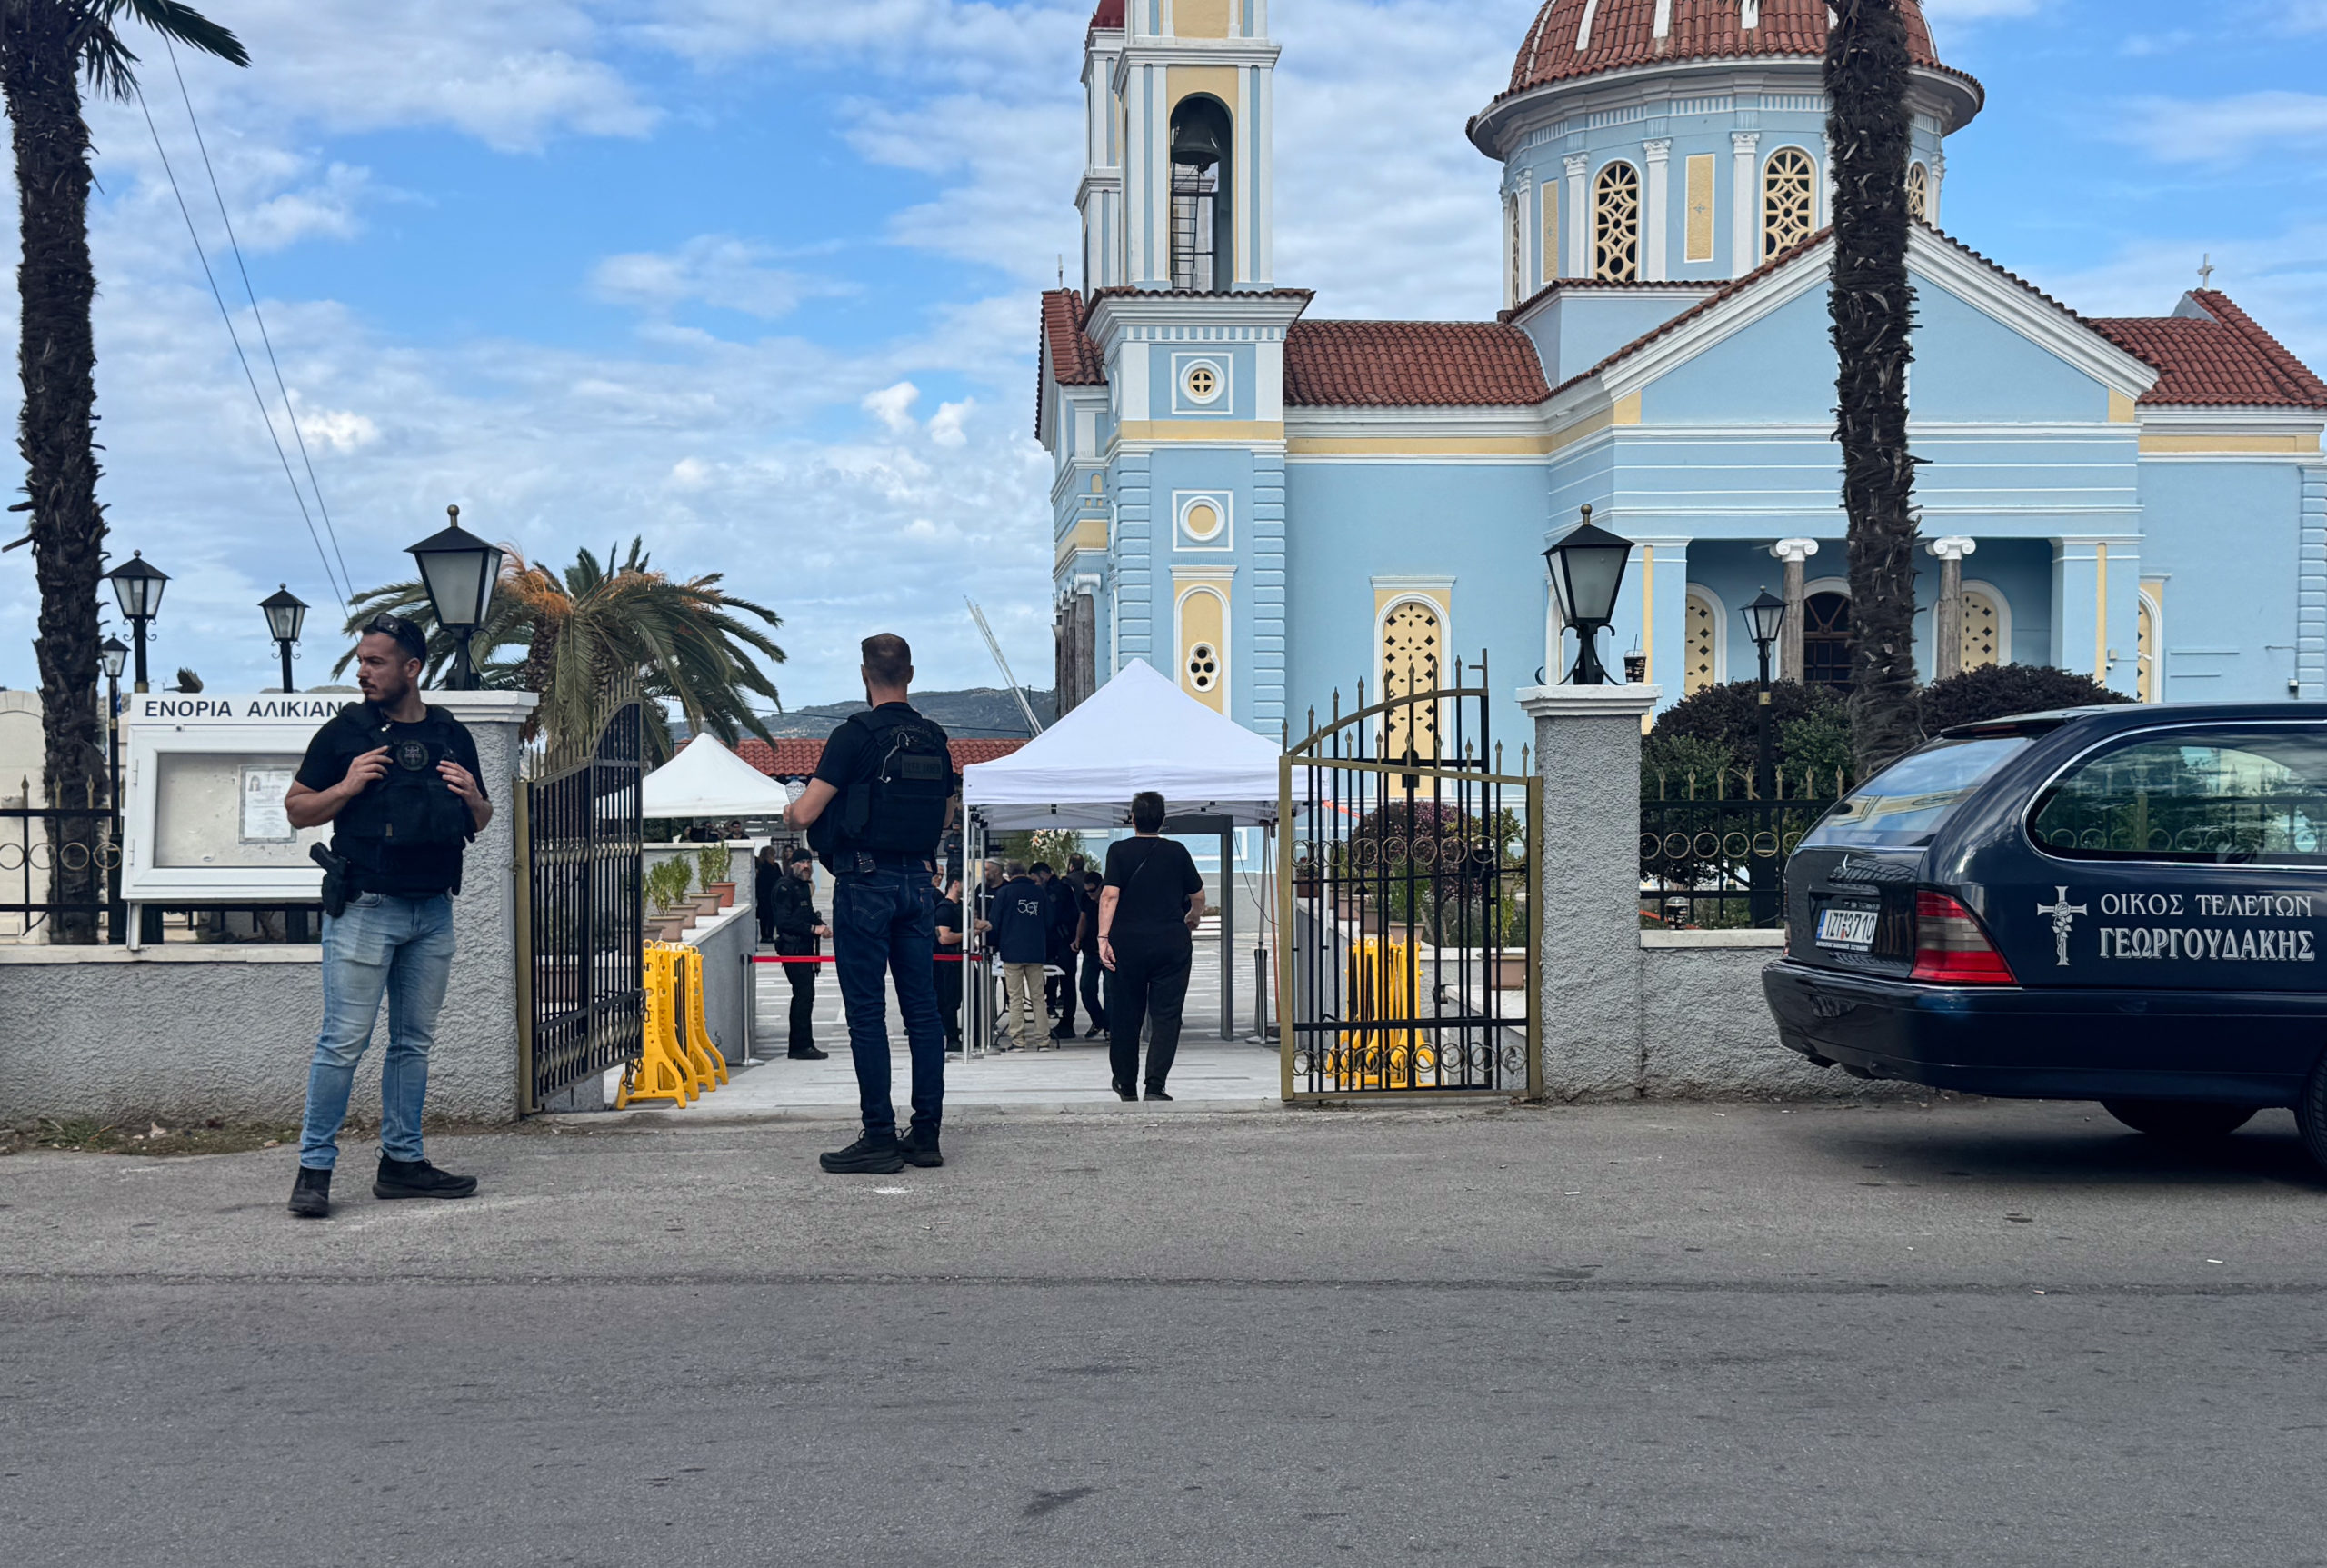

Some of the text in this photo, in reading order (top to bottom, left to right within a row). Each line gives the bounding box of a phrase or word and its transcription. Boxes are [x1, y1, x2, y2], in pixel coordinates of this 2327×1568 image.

[145, 700, 343, 717] ΕΝΟΡΙΑ ΑΛΙΚΙΑΝ
[2100, 894, 2312, 917] ΟΙΚΟΣ ΤΕΛΕΤΩΝ
[2099, 927, 2315, 961] ΓΕΩΡΓΟΥΔΑΚΗΣ
